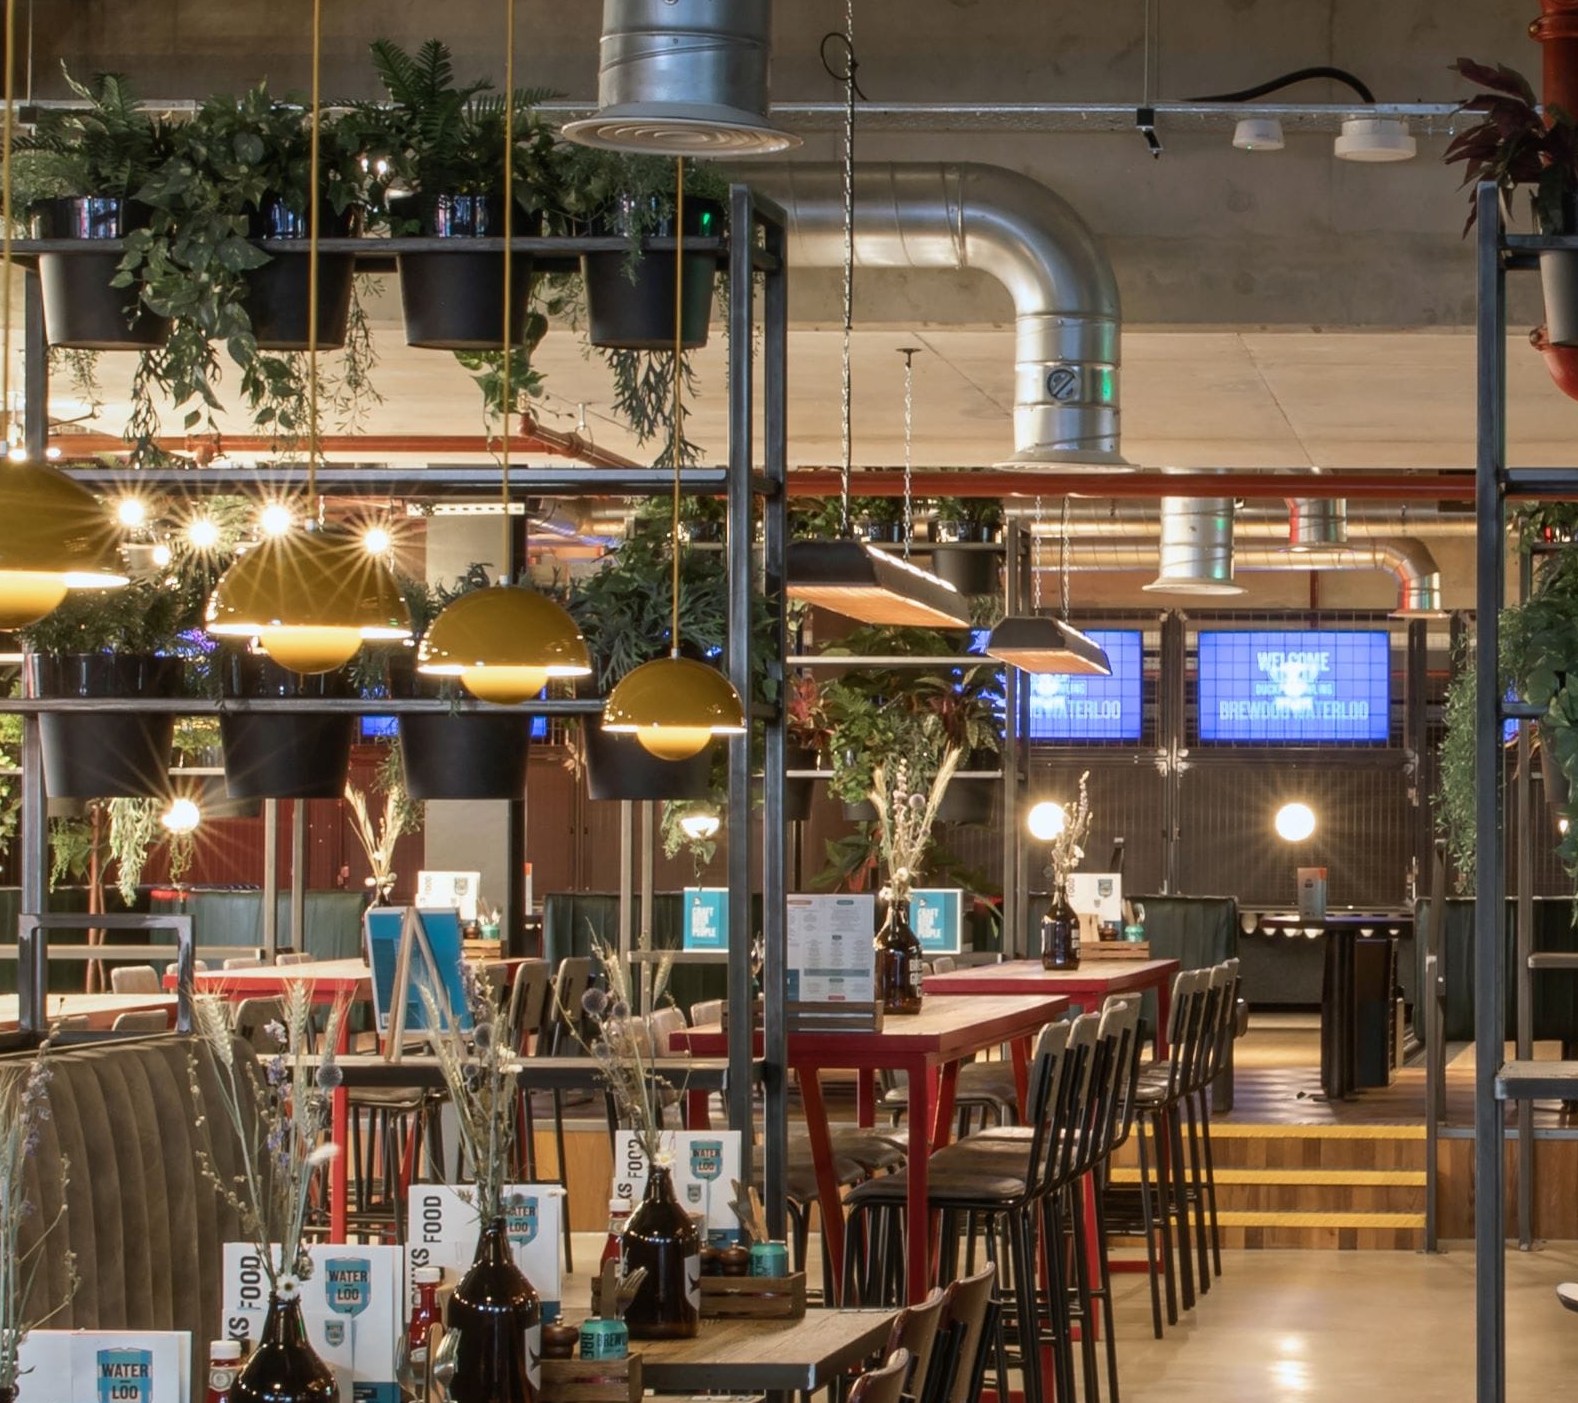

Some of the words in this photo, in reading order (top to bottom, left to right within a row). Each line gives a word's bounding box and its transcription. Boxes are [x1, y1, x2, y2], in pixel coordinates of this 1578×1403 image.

[1257, 652, 1330, 671] WELCOME
[692, 1149, 721, 1157] WATER
[508, 1206, 535, 1216] ATER
[423, 1195, 442, 1243] FOOD
[509, 1222, 528, 1232] LOO
[240, 1255, 261, 1310] FOOD
[329, 1270, 368, 1282] WATER
[337, 1288, 359, 1300] LOO
[101, 1363, 149, 1377] WATER
[112, 1385, 139, 1399] LOO
